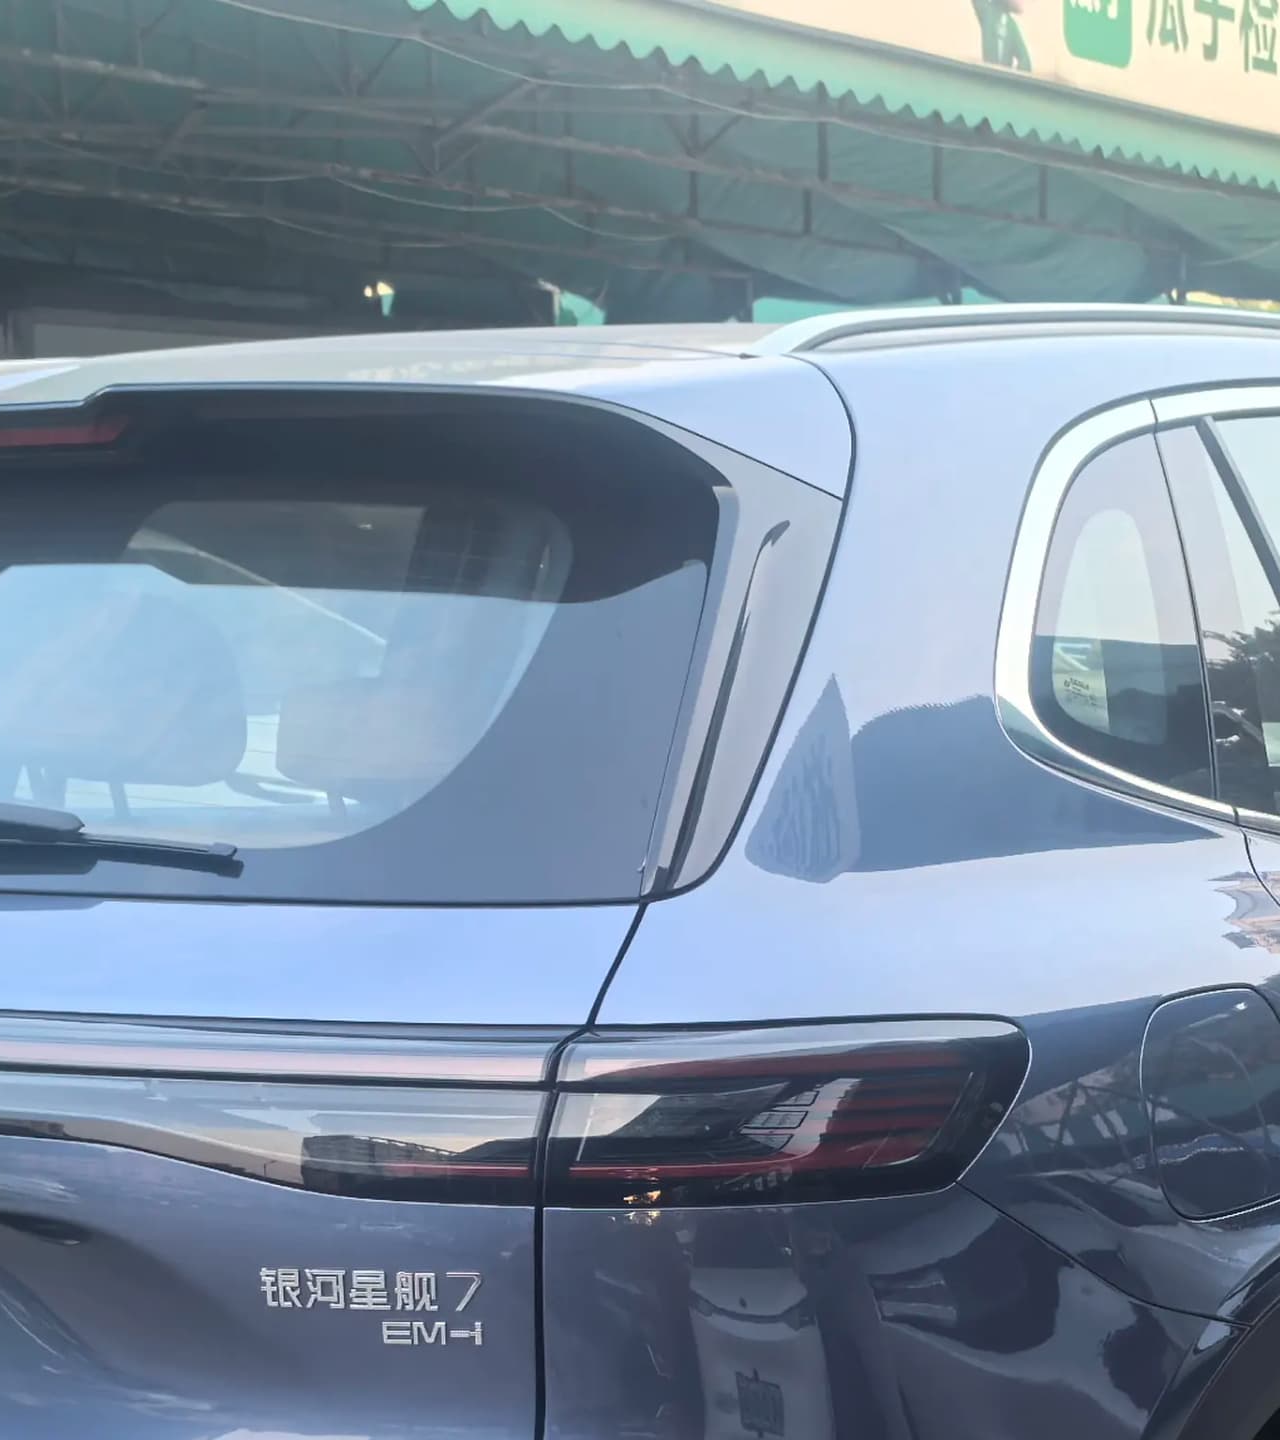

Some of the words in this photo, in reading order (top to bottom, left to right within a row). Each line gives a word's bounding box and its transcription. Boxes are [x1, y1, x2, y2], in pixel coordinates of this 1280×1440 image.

[259, 1267, 483, 1312] 银河星舰7
[381, 1321, 483, 1346] EM-i
